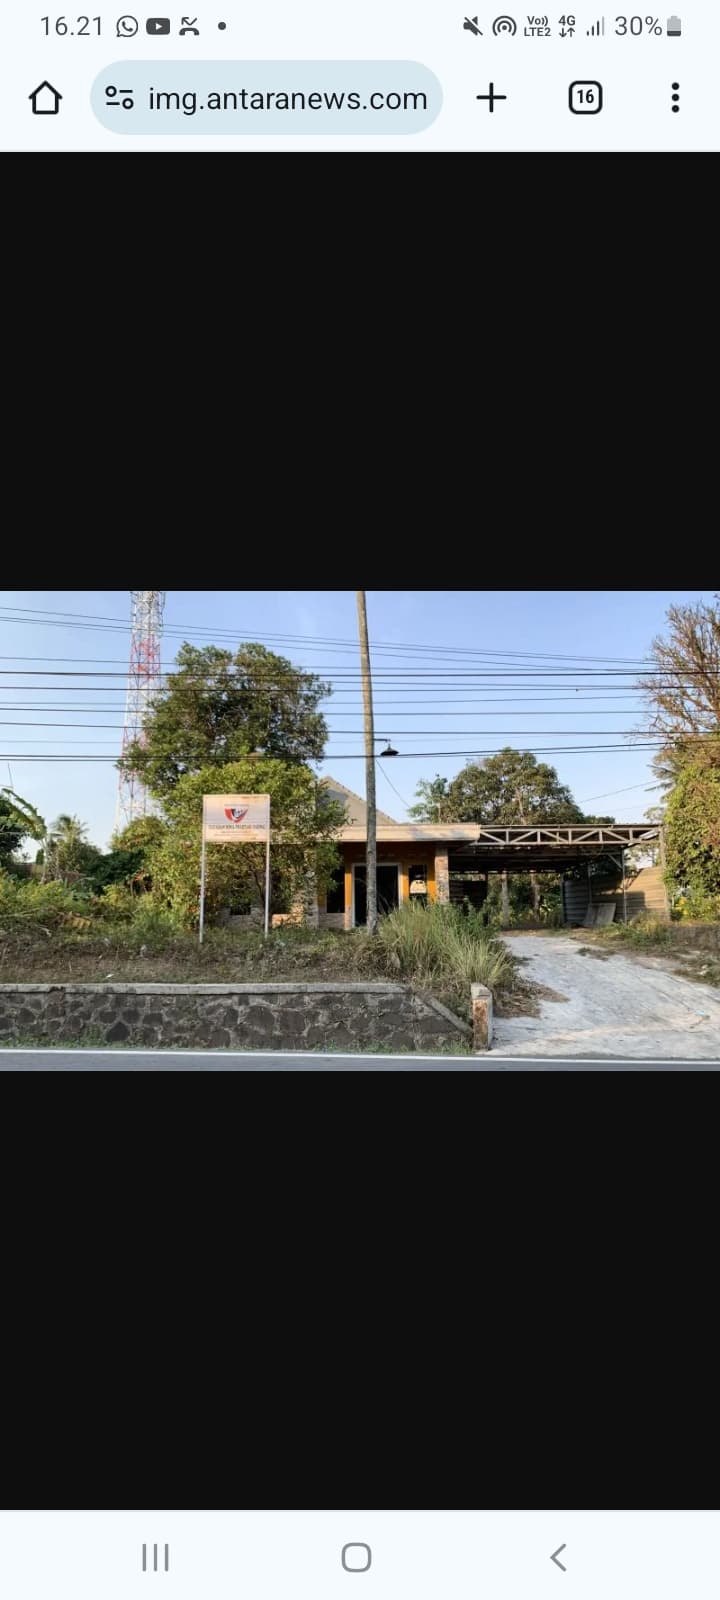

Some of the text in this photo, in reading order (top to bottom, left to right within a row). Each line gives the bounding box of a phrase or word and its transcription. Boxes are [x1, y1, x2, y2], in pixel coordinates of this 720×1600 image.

[40, 16, 104, 36] 16.21
[558, 15, 576, 26] 4G
[614, 16, 662, 36] 30%
[524, 27, 551, 36] LTE2
[149, 86, 428, 116] img.antaranews.com
[577, 89, 594, 104] 16
